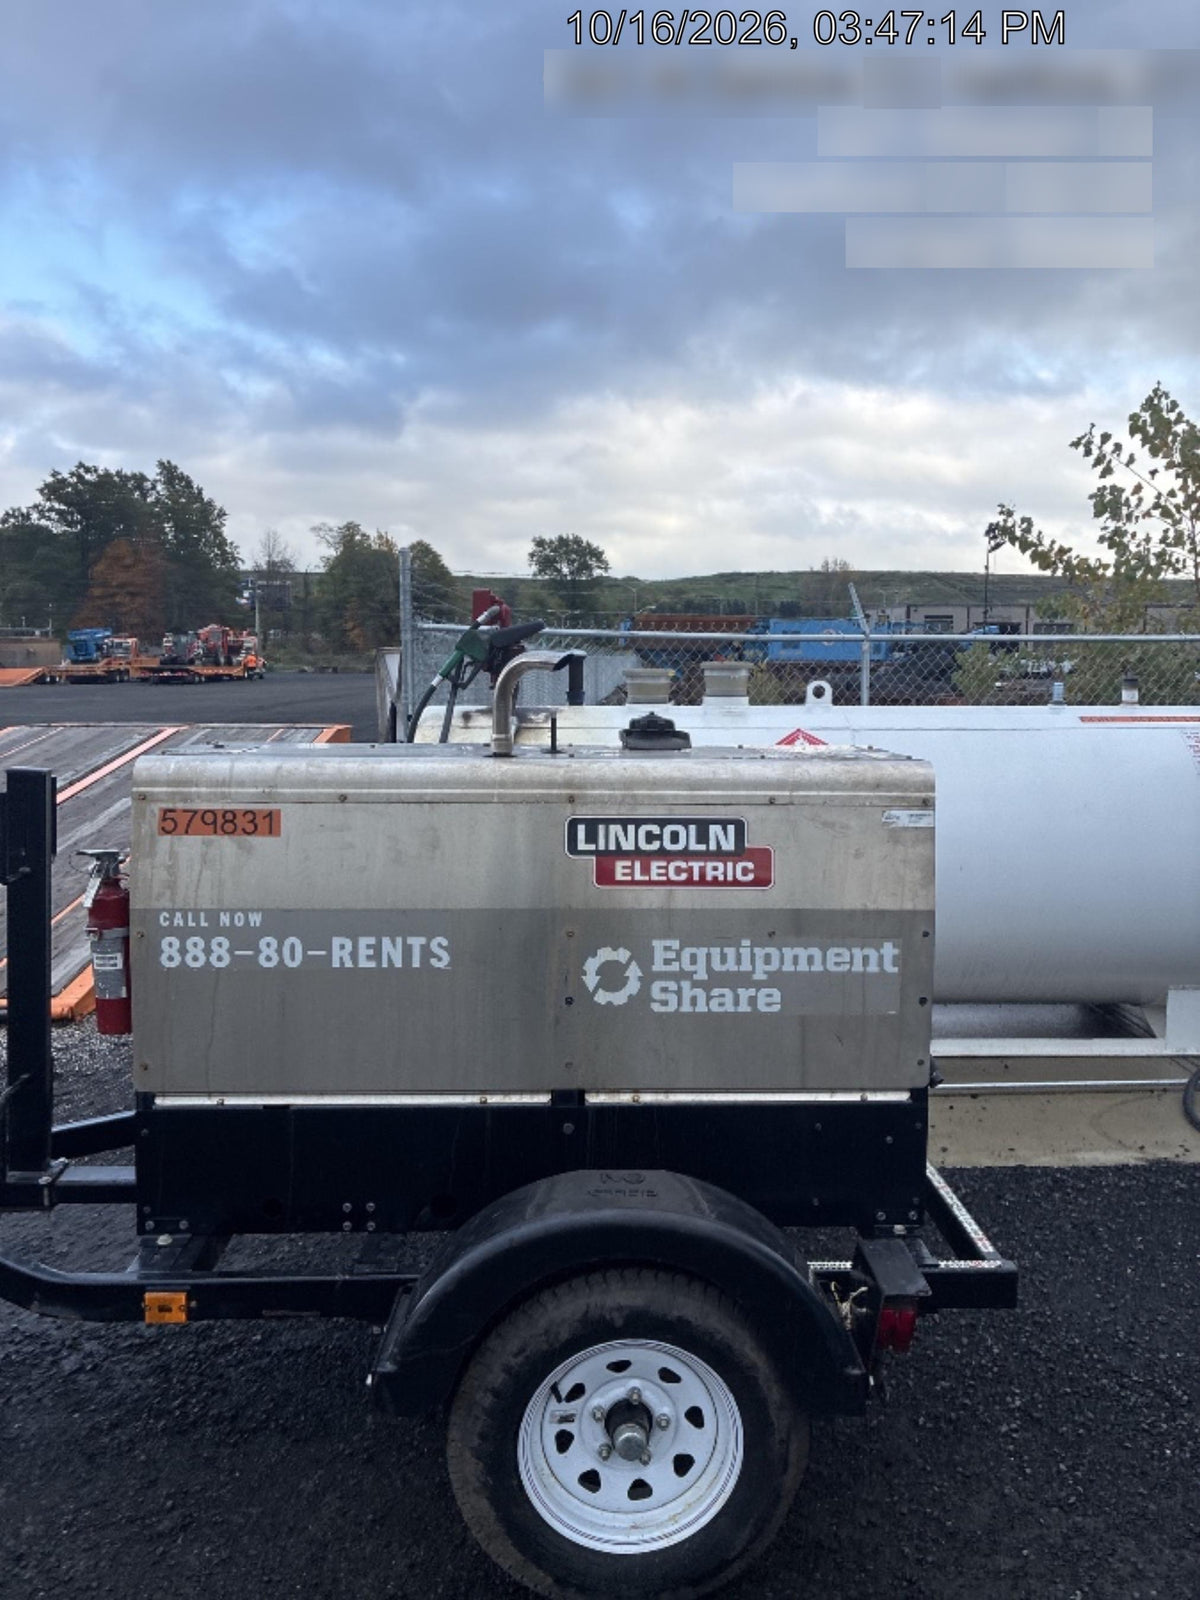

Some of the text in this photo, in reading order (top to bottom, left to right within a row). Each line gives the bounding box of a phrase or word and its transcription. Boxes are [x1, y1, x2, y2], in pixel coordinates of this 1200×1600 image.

[160, 809, 274, 836] 579831
[577, 824, 736, 851] LINCOLN
[614, 860, 755, 882] ELECTRIC
[159, 911, 263, 927] CALL NOW
[160, 936, 450, 968] 888-80-RENTS
[651, 939, 899, 980] Equipment
[650, 980, 782, 1013] Share
